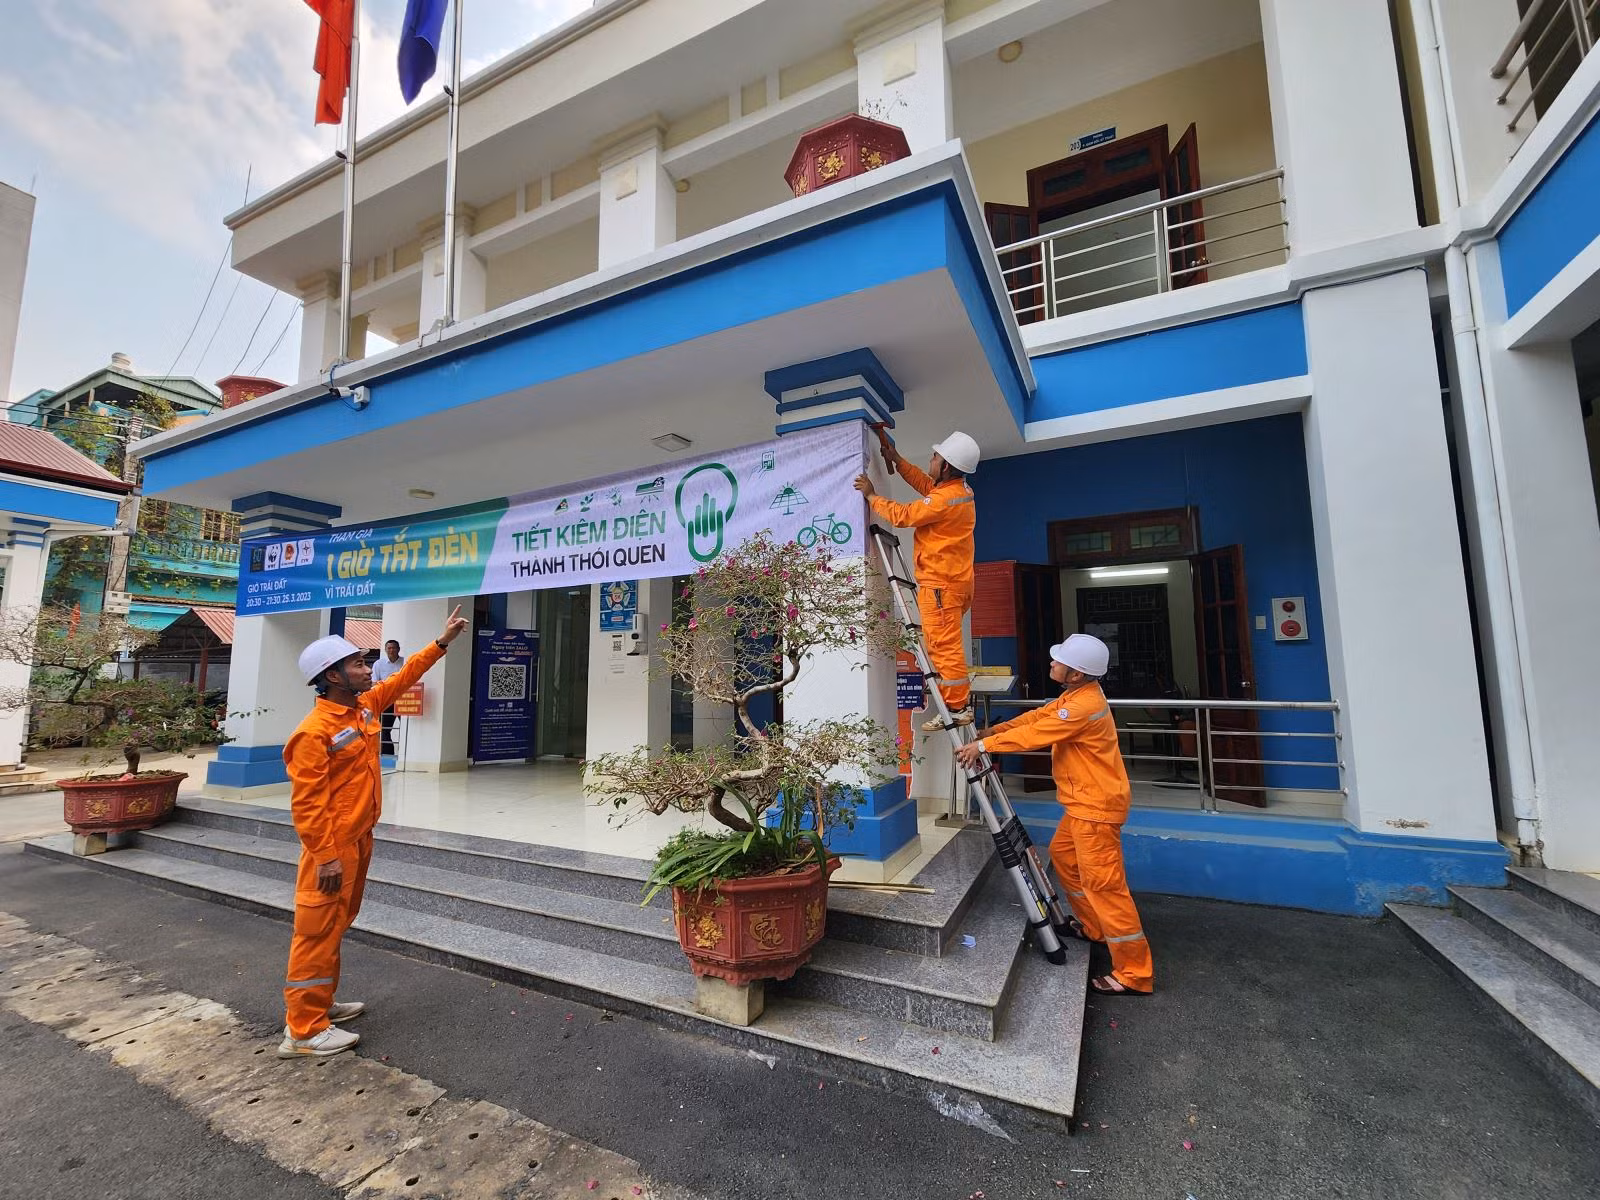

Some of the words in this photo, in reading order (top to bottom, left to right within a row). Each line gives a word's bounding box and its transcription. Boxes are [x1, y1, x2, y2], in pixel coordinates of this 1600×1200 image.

[1070, 142, 1080, 151] 203
[329, 533, 354, 543] THAM
[356, 528, 374, 539] GIA
[511, 523, 552, 553] TIẾT
[556, 518, 607, 548] KIỆM
[612, 509, 666, 541] ĐIỆN
[337, 540, 375, 579] GIỜ
[380, 527, 422, 574] TẮT
[427, 527, 479, 569] ĐÈN
[510, 556, 565, 578] THÀNH
[568, 547, 610, 572] THÓI
[613, 543, 666, 567] QUEN
[260, 580, 273, 592] TRÁI
[273, 578, 288, 590] ĐẤT
[325, 585, 334, 599] VÌ
[336, 582, 355, 598] TRÁI
[356, 579, 376, 595] ĐẤT
[246, 597, 262, 608] 20:30
